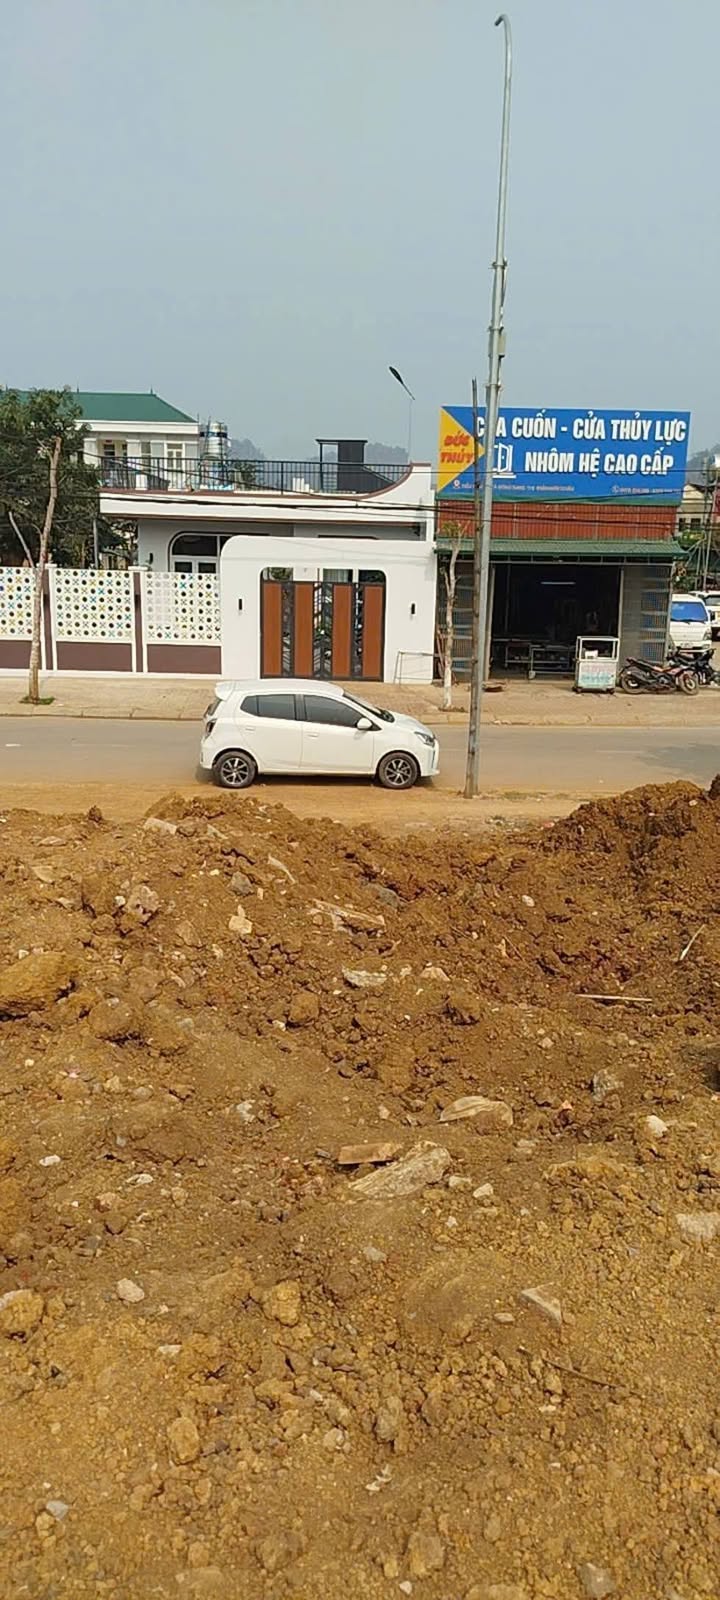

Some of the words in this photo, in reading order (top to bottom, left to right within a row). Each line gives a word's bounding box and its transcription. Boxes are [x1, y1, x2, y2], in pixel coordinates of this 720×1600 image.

[476, 414, 507, 438] CA
[511, 409, 557, 438] CUỐN
[573, 410, 606, 439] CỬA
[610, 412, 651, 440] THỦY
[655, 416, 687, 446] LỰC
[525, 446, 574, 473] NHÔM
[579, 449, 600, 478] HỆ
[604, 454, 637, 475] CAO
[640, 446, 674, 475] CẤP
